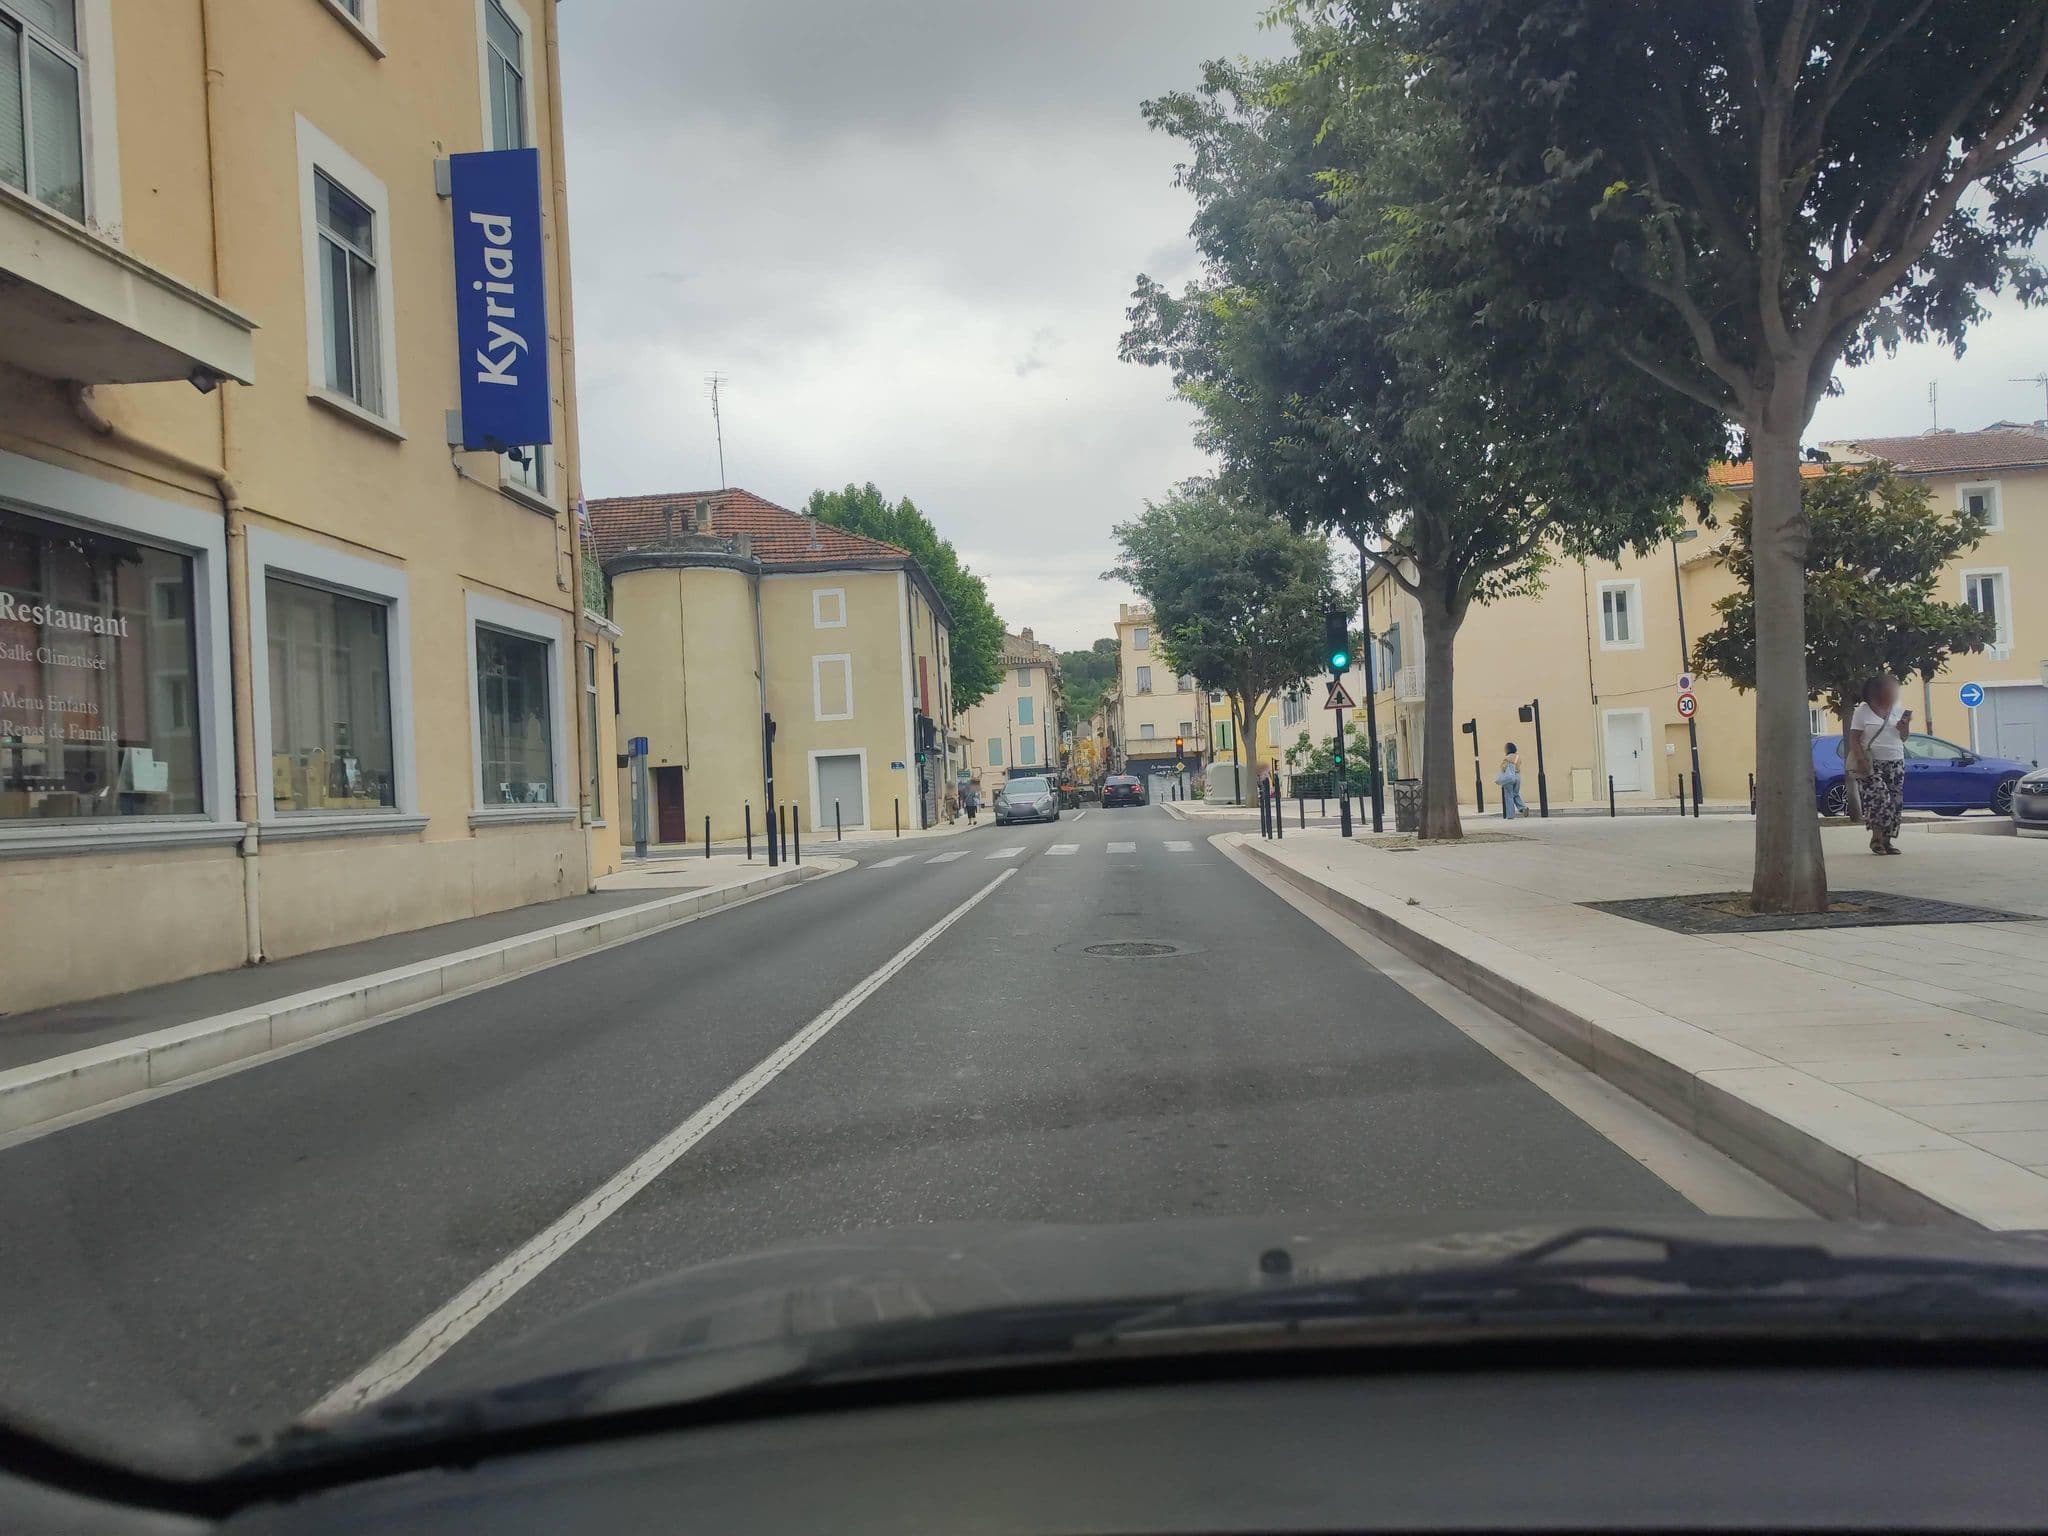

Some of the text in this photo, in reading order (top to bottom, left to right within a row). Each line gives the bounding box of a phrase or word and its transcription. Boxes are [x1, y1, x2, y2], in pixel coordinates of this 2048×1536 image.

[469, 211, 529, 386] Kyriad
[0, 591, 128, 637] Restaurant
[0, 642, 107, 671] Salle Climatisée
[1, 691, 99, 715] Menu Enfants
[1681, 699, 1693, 711] 30
[49, 723, 65, 739] de
[69, 723, 118, 742] Famille
